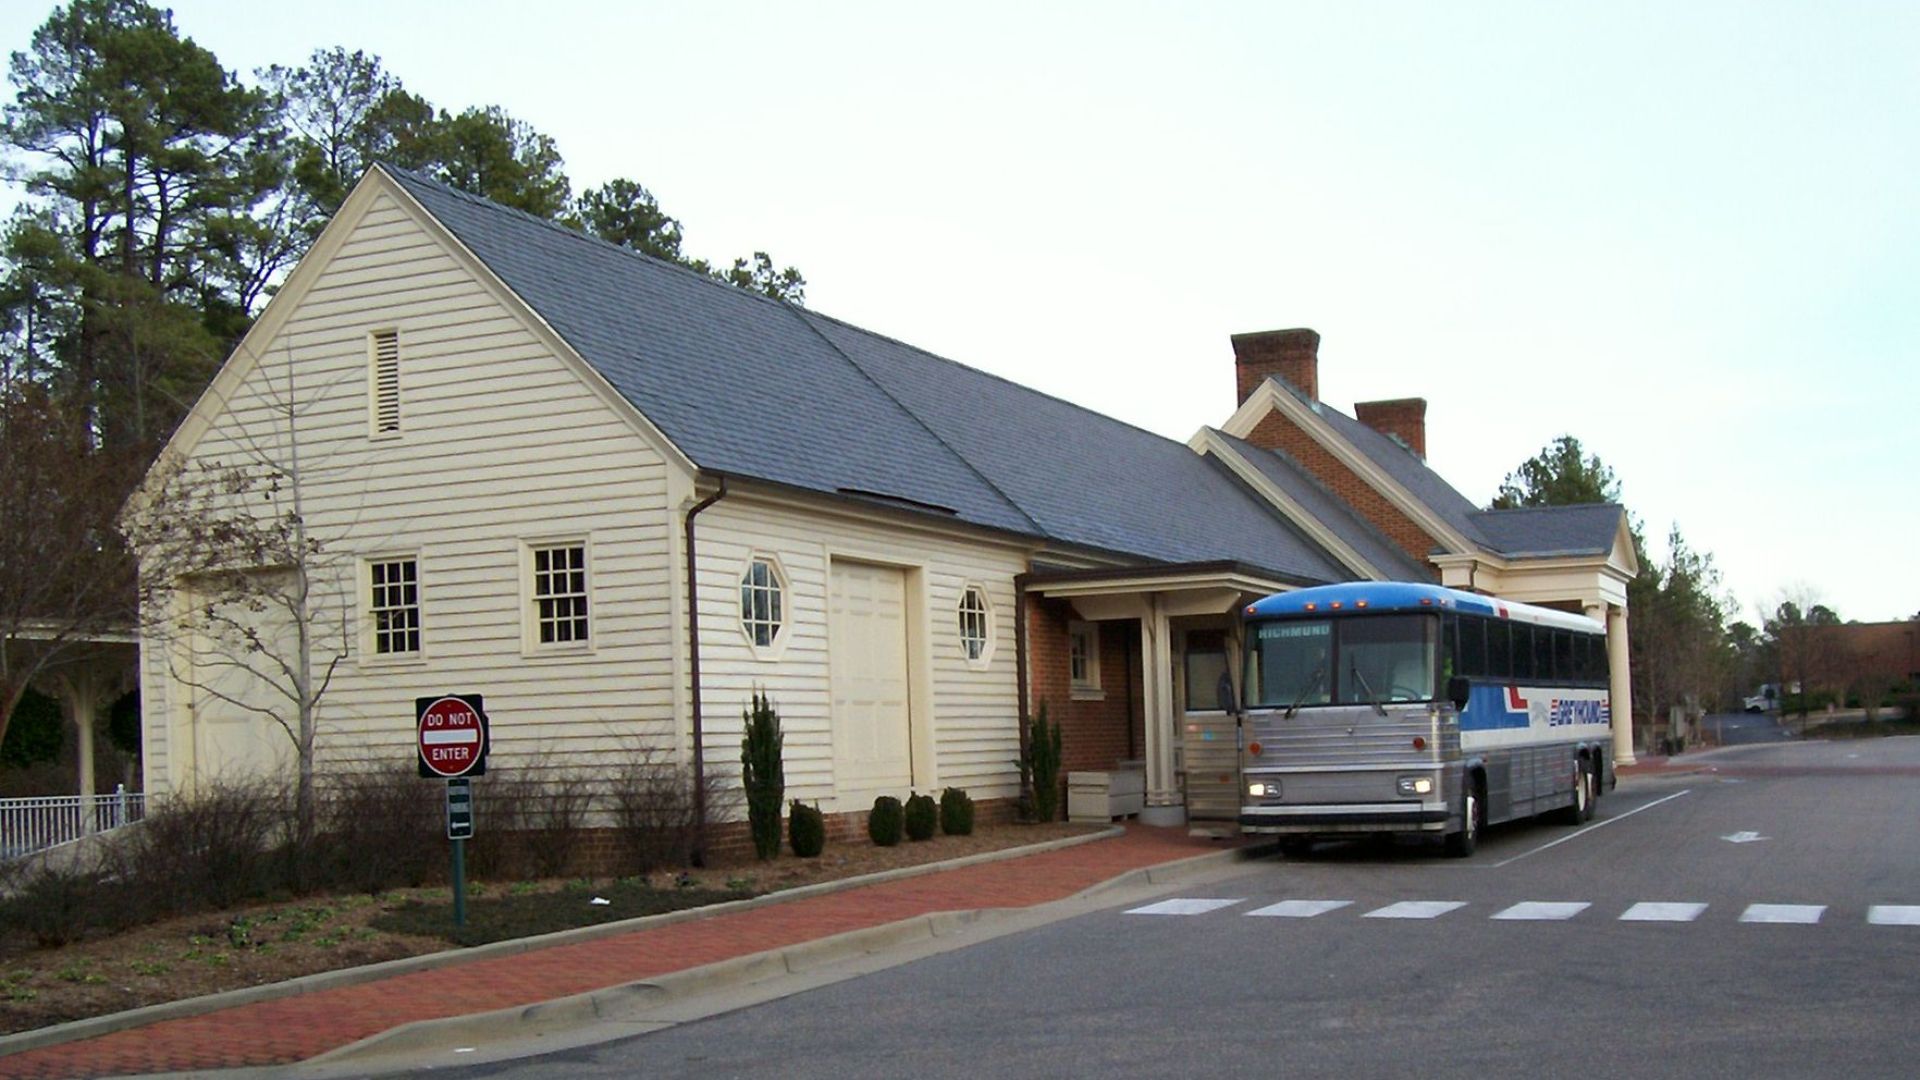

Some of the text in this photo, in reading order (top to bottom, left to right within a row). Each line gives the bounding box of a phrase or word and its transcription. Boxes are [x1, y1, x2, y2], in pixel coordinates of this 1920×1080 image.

[1258, 624, 1330, 639] RICHMOND
[427, 712, 472, 726] DO NOT
[1558, 699, 1601, 725] GREYHOUND
[432, 747, 469, 760] ENTER
